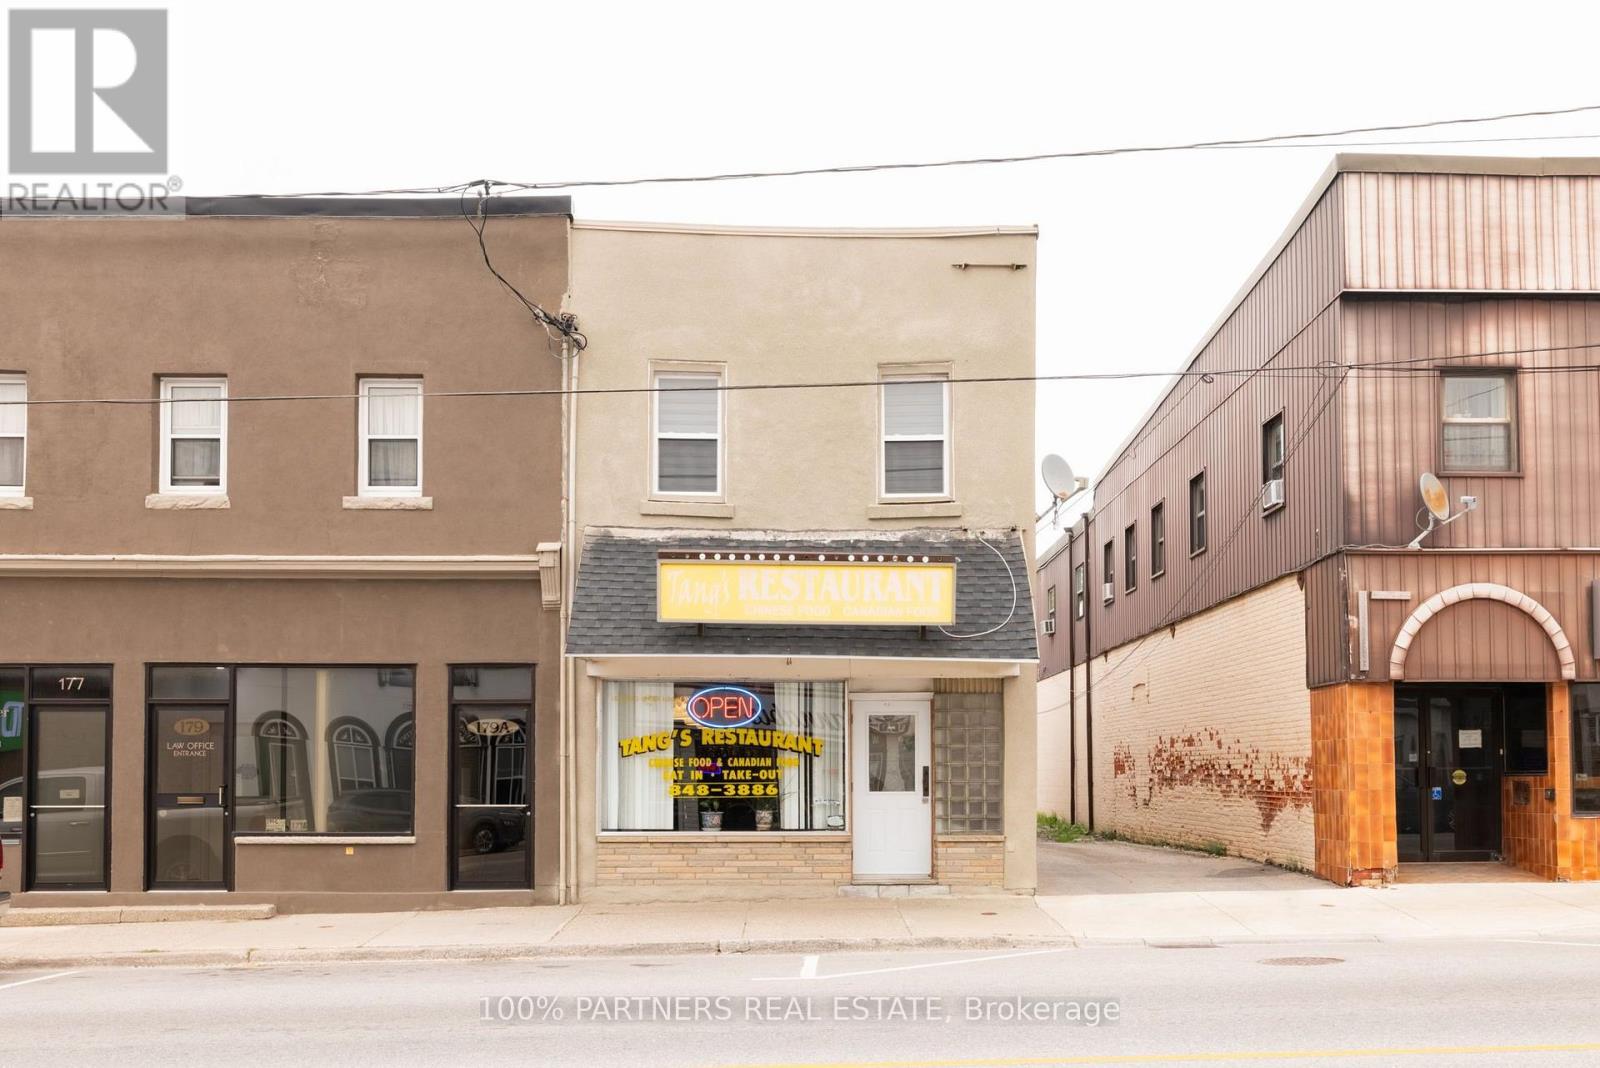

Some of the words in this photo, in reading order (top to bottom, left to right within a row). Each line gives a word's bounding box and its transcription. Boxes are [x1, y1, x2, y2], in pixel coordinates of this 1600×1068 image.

[738, 569, 947, 601] RESTAURANT
[58, 677, 85, 690] 177
[692, 696, 753, 719] OPEN
[180, 720, 204, 733] 179
[476, 721, 511, 734] 179A
[167, 741, 185, 750] LAW
[187, 741, 215, 750] OFFICE
[618, 728, 692, 758] TANG'S
[701, 727, 825, 757] RESTAURANT
[688, 757, 712, 768] FOOD
[727, 757, 772, 767] CANADIAN
[690, 769, 704, 780] IN
[722, 769, 783, 780] TAKE-OUT
[669, 784, 778, 796] 848-3886
